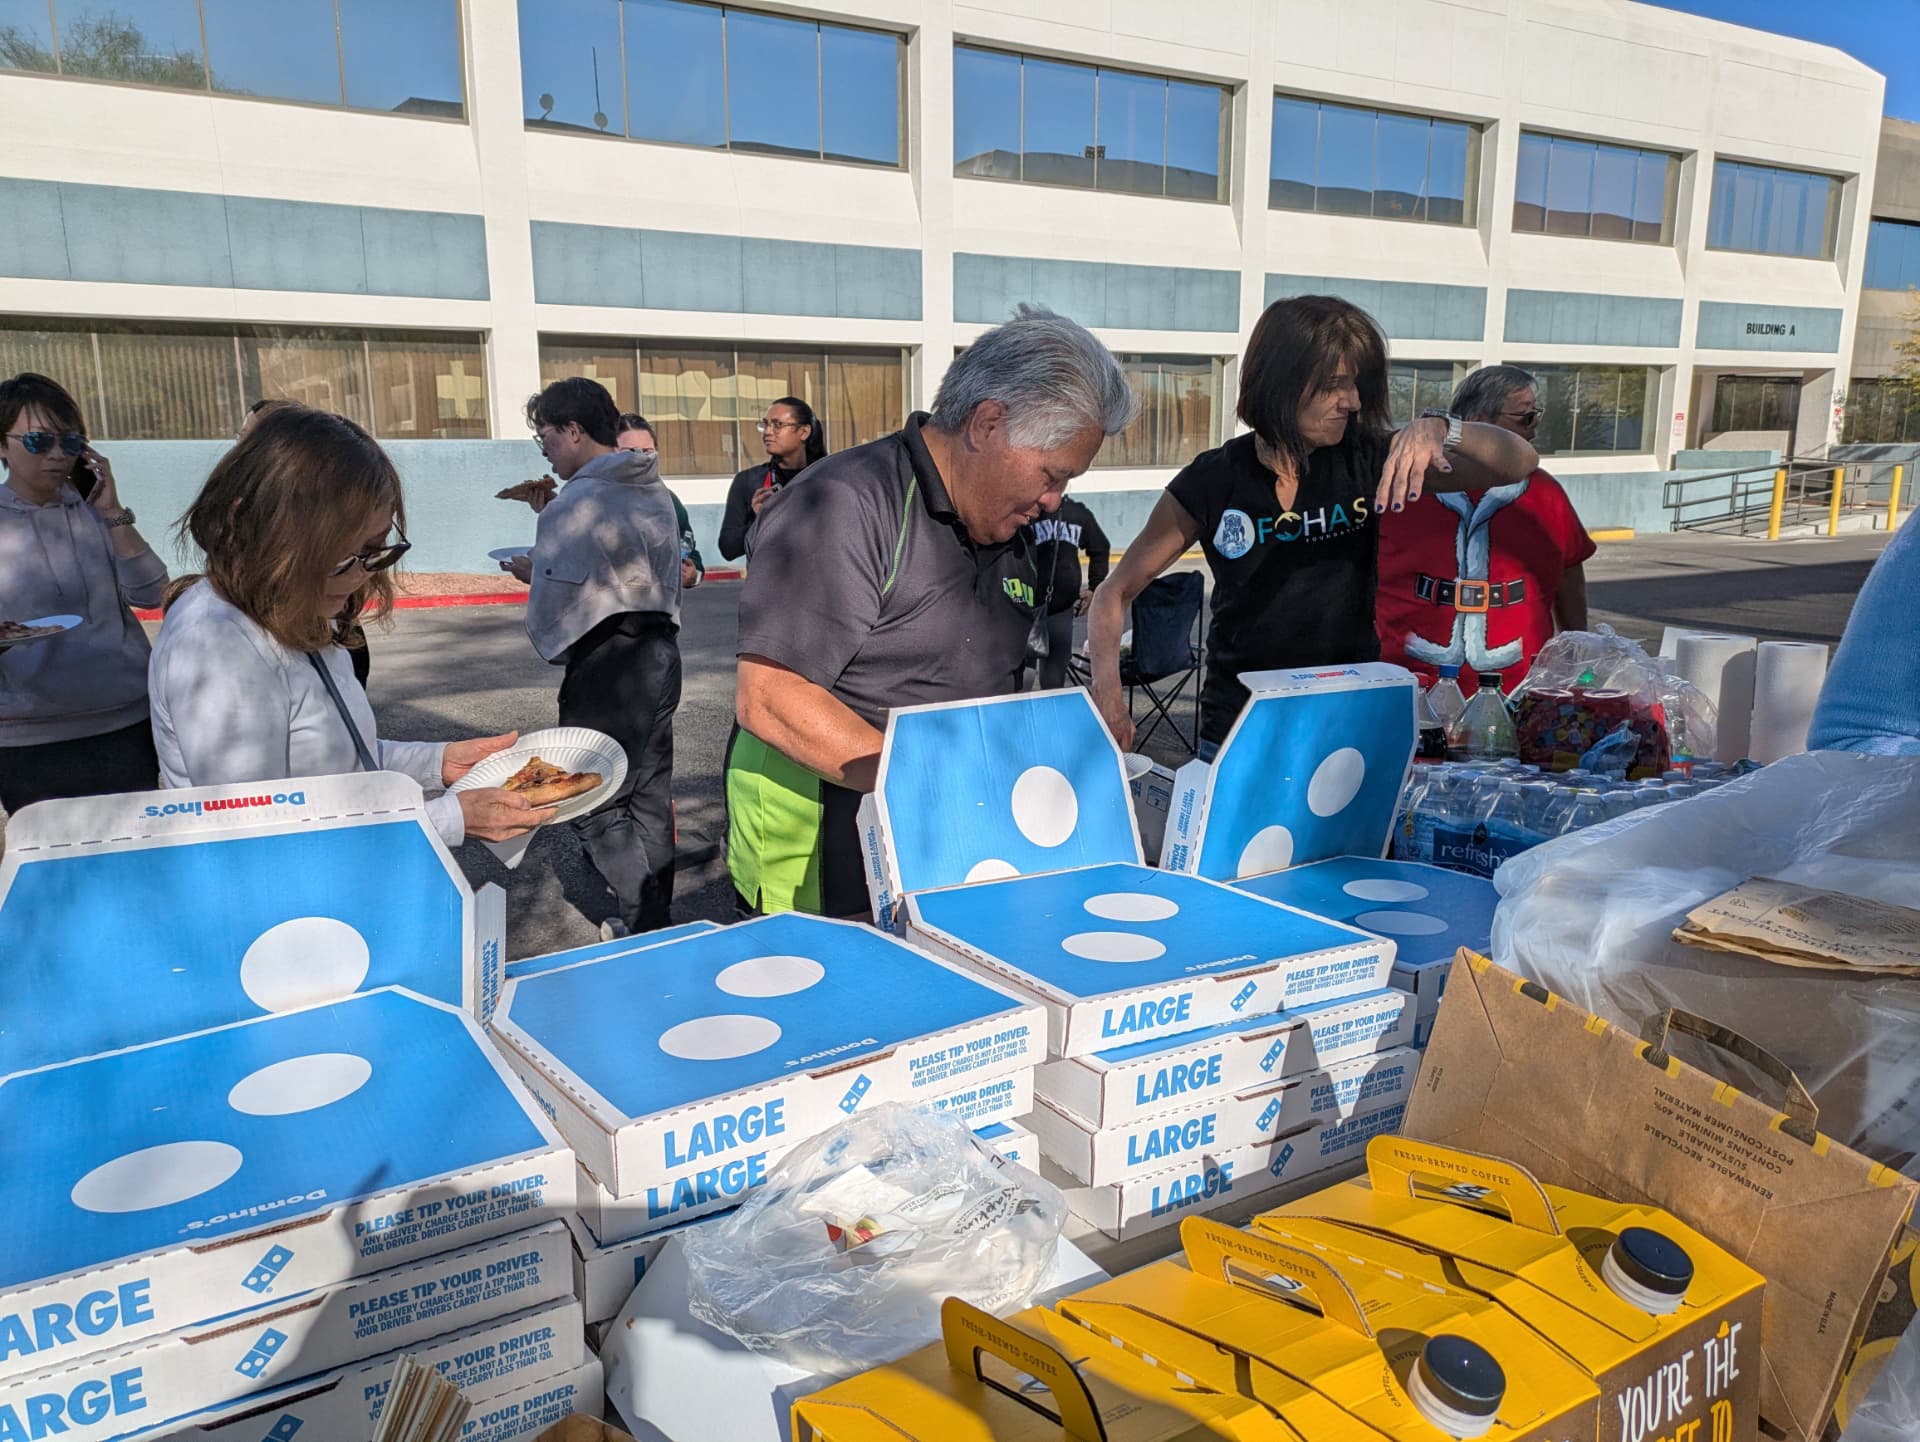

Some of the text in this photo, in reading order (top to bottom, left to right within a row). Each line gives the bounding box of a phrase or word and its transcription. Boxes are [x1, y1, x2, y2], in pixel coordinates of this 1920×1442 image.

[1747, 322, 1795, 336] BUILDING A
[1257, 497, 1368, 544] FOHAS
[145, 791, 306, 817] Dommmino's
[1441, 843, 1501, 868] refresh
[1286, 955, 1380, 982] PLEASE TIP YOUR DRIVER.
[1102, 992, 1193, 1038] LARGE
[1313, 1024, 1340, 1039] PLEASE
[1341, 1020, 1354, 1031] TIP
[1354, 1014, 1375, 1027] YOUR
[910, 1025, 1030, 1071] PLEASE TIP YOUR DRIVER.
[950, 1090, 977, 1107] YOUR
[979, 1080, 1016, 1099] DRIVER.
[1136, 1053, 1222, 1106] LARGE
[1311, 1082, 1339, 1098] PLEASE
[1341, 1078, 1353, 1090] TIP
[1355, 1072, 1378, 1085] YOUR
[664, 1097, 785, 1169] LARGE
[1127, 1113, 1216, 1166] LARGE
[1320, 1125, 1346, 1141] PLEASE
[1347, 1120, 1359, 1131] TIP
[1360, 1113, 1379, 1125] YOUR
[1653, 1087, 1794, 1166] POST-CONSUMER MATERIAL
[1654, 1102, 1782, 1174] CONTAINS MINIMUM 40%
[1679, 1129, 1748, 1170] SUSTAINABLE
[1394, 1149, 1511, 1185] FRESH-BREWED COFFEE
[1644, 1123, 1774, 1200] RENEWABLE, RECYCLABLE
[187, 1188, 327, 1231] Domino's
[355, 1174, 548, 1237] PLEASE TIP YOUR DRIVER.
[647, 1152, 768, 1220] LARGE
[1152, 1161, 1234, 1218] LARGE
[359, 1244, 385, 1258] YOUR
[385, 1235, 420, 1251] DRIVER.
[421, 1223, 457, 1241] DRIVERS
[458, 1215, 485, 1229] CARRY
[487, 1209, 506, 1221] LESS
[508, 1202, 529, 1215] THAN
[363, 1190, 541, 1248] ANY DELIVERY CHARGE IS NOT A TIP PAID TO
[1205, 1231, 1317, 1279] FRESH-BREWED COFFEE
[349, 1251, 544, 1319] PLEASE TIP YOUR DRIVER.
[357, 1267, 538, 1329] ANY DELIVERY CHARGE IS NOT A TIP PAID TO
[0, 1277, 155, 1362] ARGE
[353, 1325, 379, 1340] YOUR
[380, 1316, 414, 1332] DRIVER.
[416, 1303, 452, 1321] DRIVERS
[453, 1295, 481, 1309] CARRY
[483, 1288, 502, 1300] LESS
[503, 1281, 526, 1295] THAN
[453, 1347, 496, 1371] YOUR
[499, 1326, 556, 1357] DRIVER.
[469, 1366, 477, 1375] IS
[479, 1360, 496, 1372] NOT
[498, 1357, 504, 1366] A
[506, 1352, 518, 1363] TIP
[520, 1347, 538, 1359] PAID
[539, 1342, 550, 1352] TO
[961, 1317, 1058, 1376] FRESH-BREWED COFFEE
[466, 1370, 494, 1386] CARRY
[496, 1363, 514, 1376] LESS
[516, 1356, 538, 1370] THAN
[1618, 1322, 1742, 1442] YOU'RE THE
[0, 1366, 147, 1442] ARGE
[462, 1384, 578, 1435] IP YOUR DRIVER.
[495, 1426, 502, 1434] IS
[504, 1420, 520, 1430] NOT
[529, 1412, 540, 1420] TIP
[541, 1404, 560, 1416] PAID
[562, 1400, 572, 1408] TO
[520, 1422, 537, 1433] LESS
[540, 1413, 560, 1425] THAN
